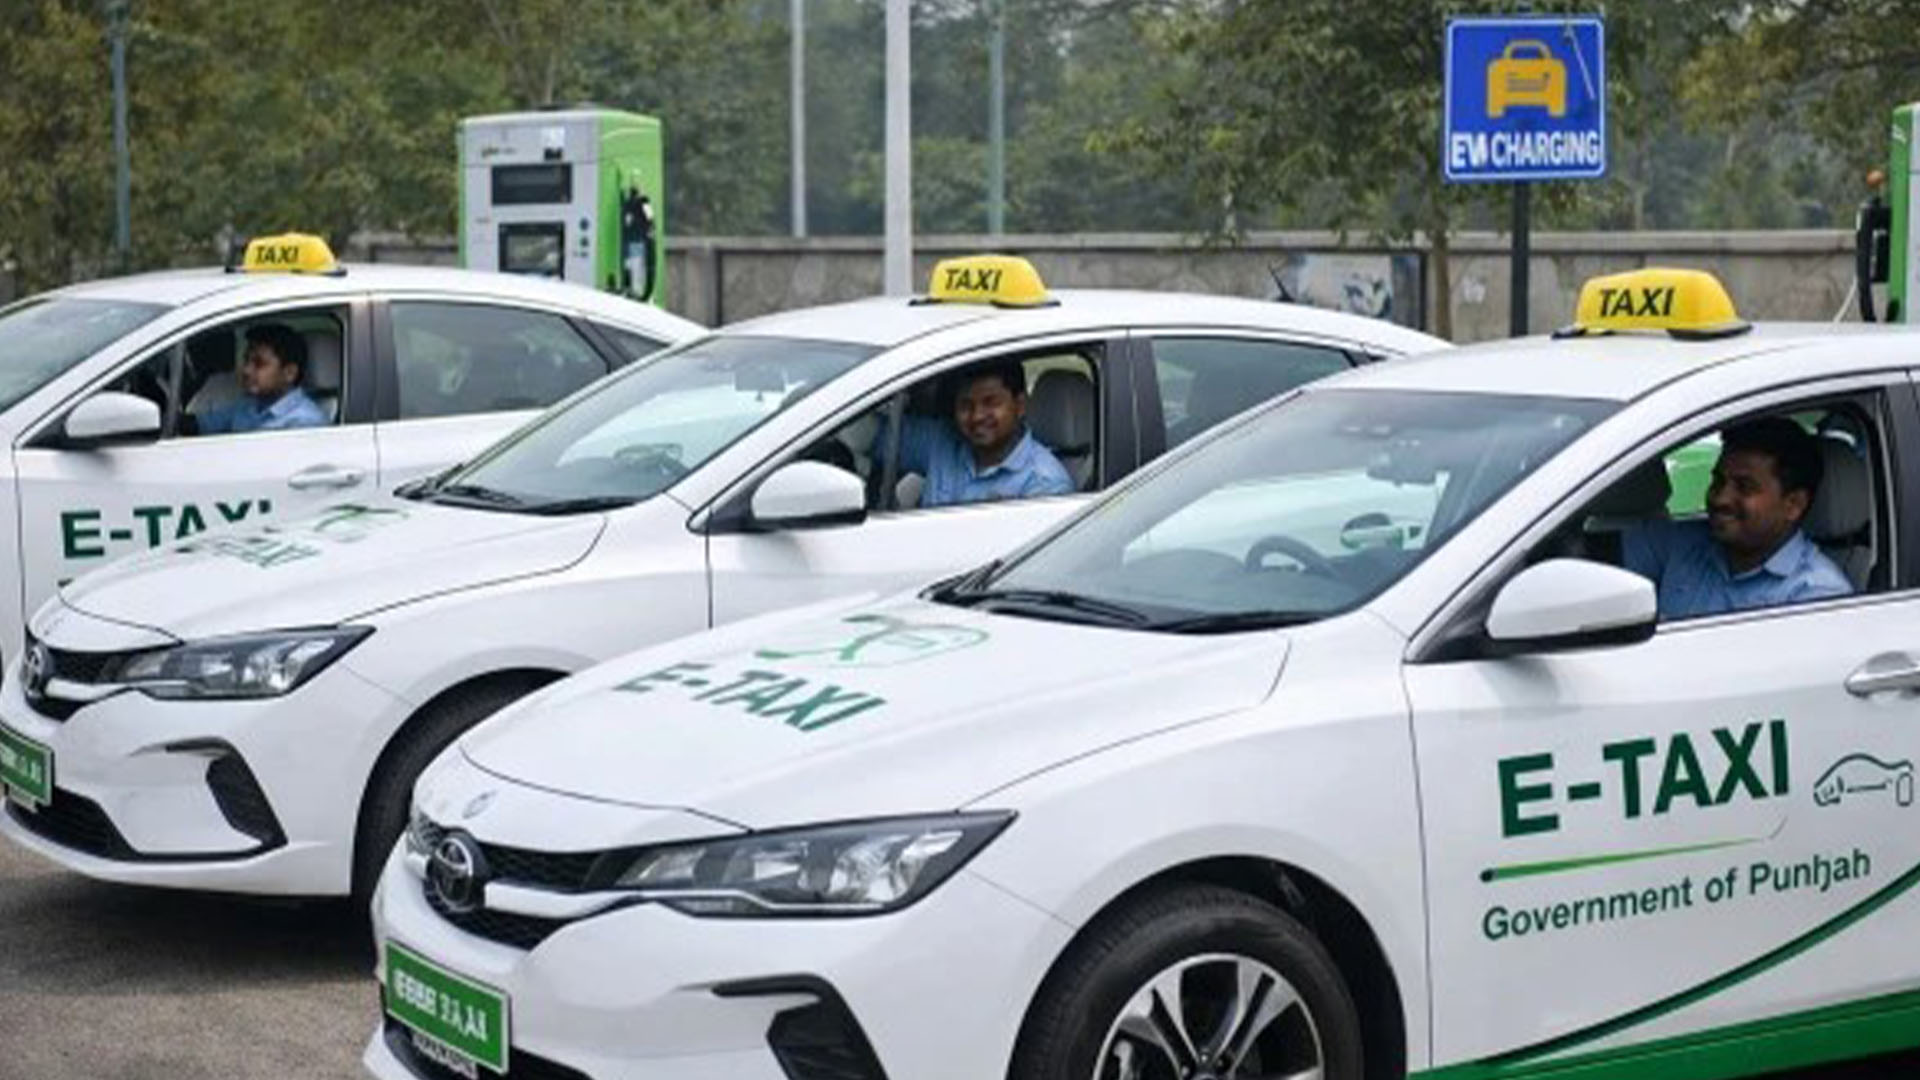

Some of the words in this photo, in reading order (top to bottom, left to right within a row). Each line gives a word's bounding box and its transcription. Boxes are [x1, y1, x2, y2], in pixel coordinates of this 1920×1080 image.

[1490, 130, 1599, 168] CHARGING
[255, 245, 300, 264] TAXI
[944, 268, 1003, 292] TAXI
[1600, 286, 1675, 317] TAXI
[612, 662, 886, 732] E-TAXI
[1497, 719, 1790, 838] E-TAXI
[1482, 875, 1693, 941] Government
[1704, 867, 1737, 903] of
